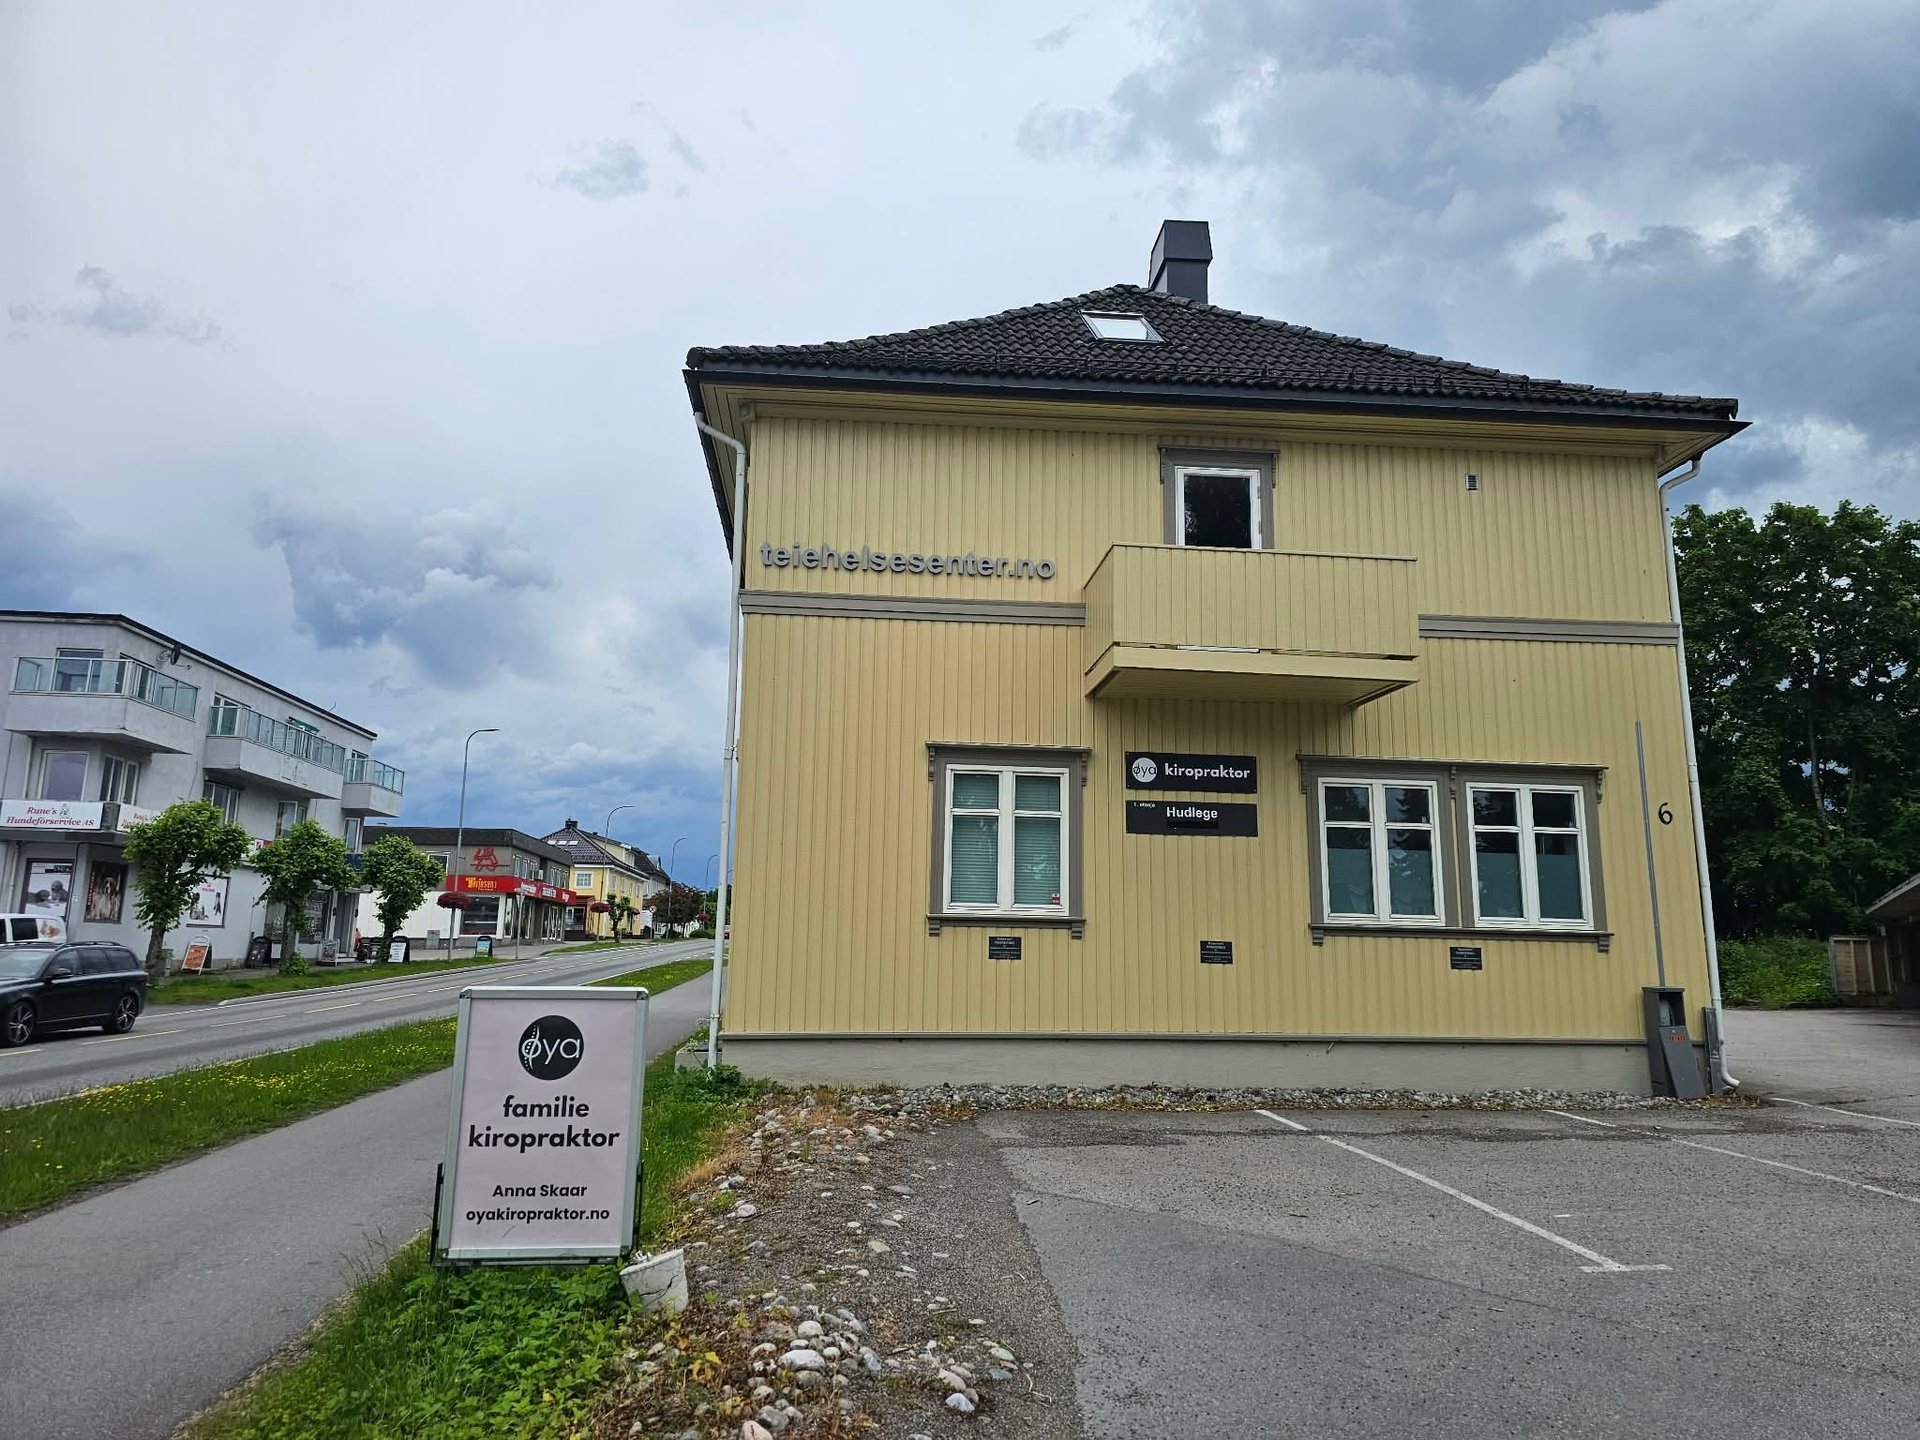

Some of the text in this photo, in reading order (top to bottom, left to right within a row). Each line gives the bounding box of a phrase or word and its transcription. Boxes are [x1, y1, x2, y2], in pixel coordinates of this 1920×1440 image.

[760, 541, 1056, 579] teiehelsesenter.no
[1164, 763, 1250, 780] kiropraktor
[27, 806, 58, 815] Rune's
[1166, 806, 1218, 821] Hudlege
[1658, 802, 1673, 825] 6
[503, 1095, 590, 1118] familie
[468, 1125, 620, 1153] kiropraktor
[492, 1184, 587, 1198] Anna Skaar
[466, 1207, 610, 1225] oyakiropraktor.no
